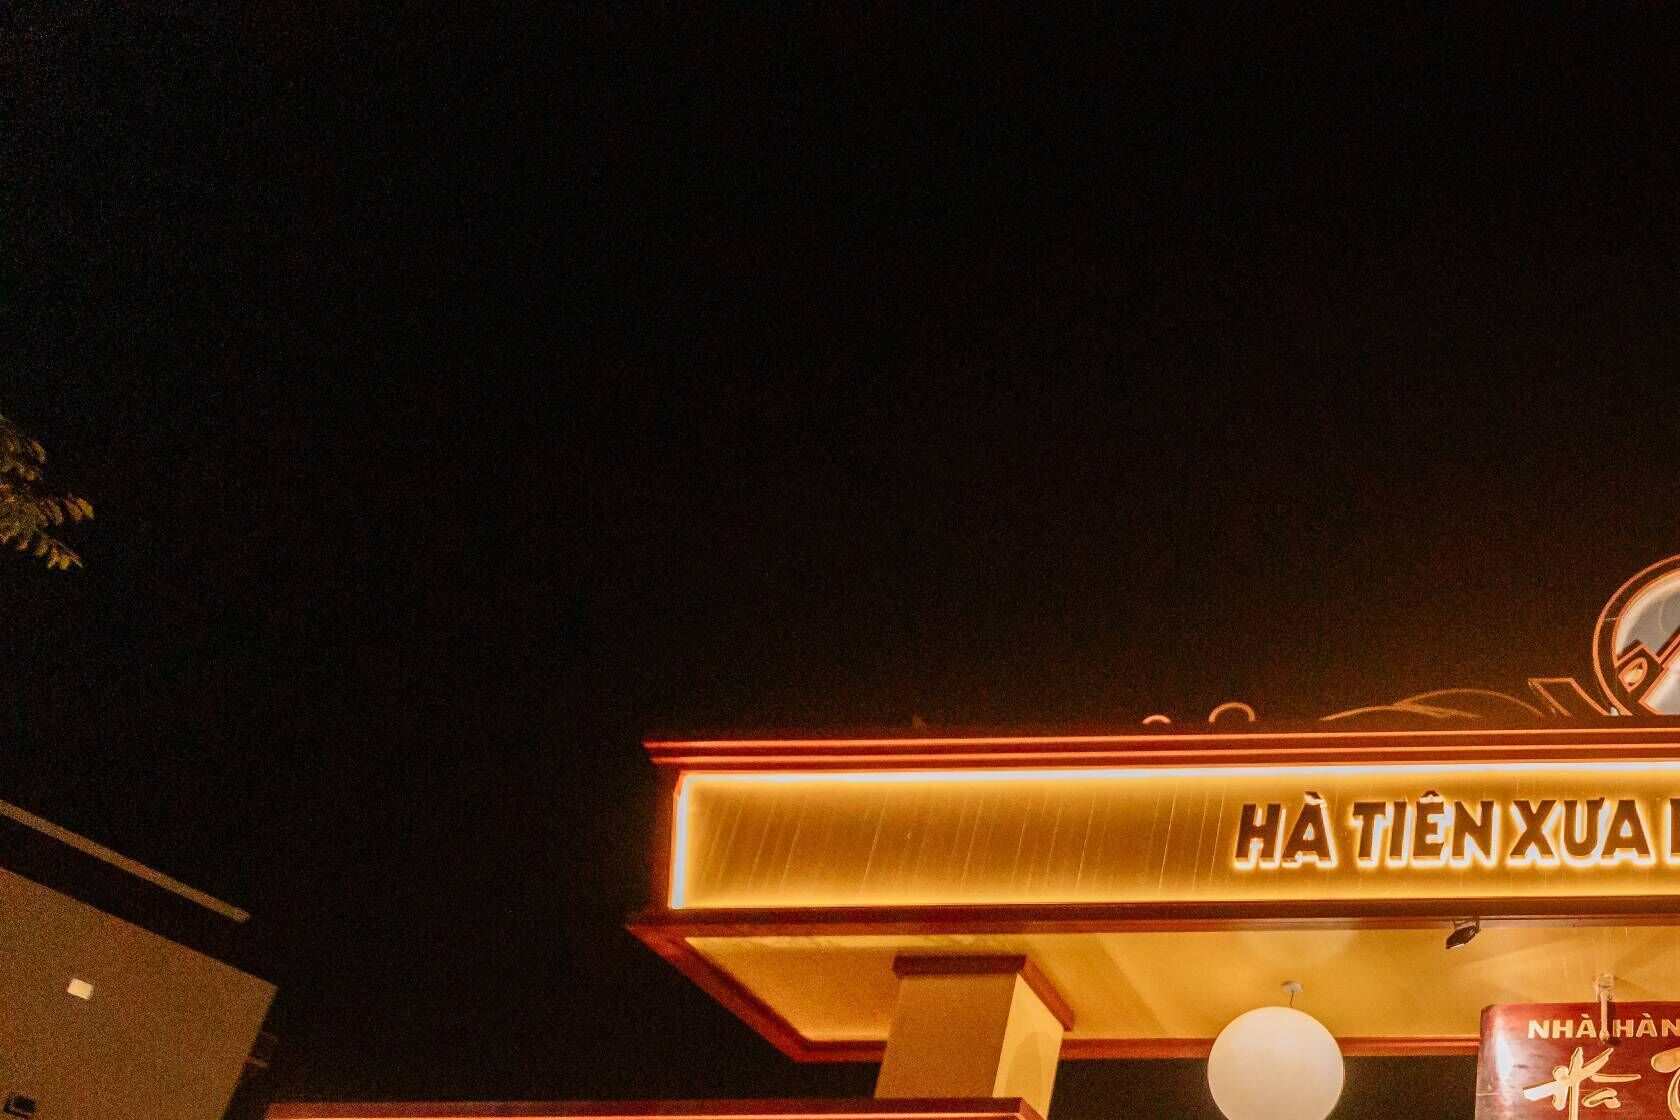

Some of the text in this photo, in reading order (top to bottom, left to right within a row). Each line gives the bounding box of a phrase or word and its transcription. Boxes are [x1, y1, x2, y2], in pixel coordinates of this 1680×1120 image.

[1234, 790, 1336, 866] HÀ
[1350, 790, 1498, 866] TIÊN
[1527, 1013, 1597, 1039] NHÀ
